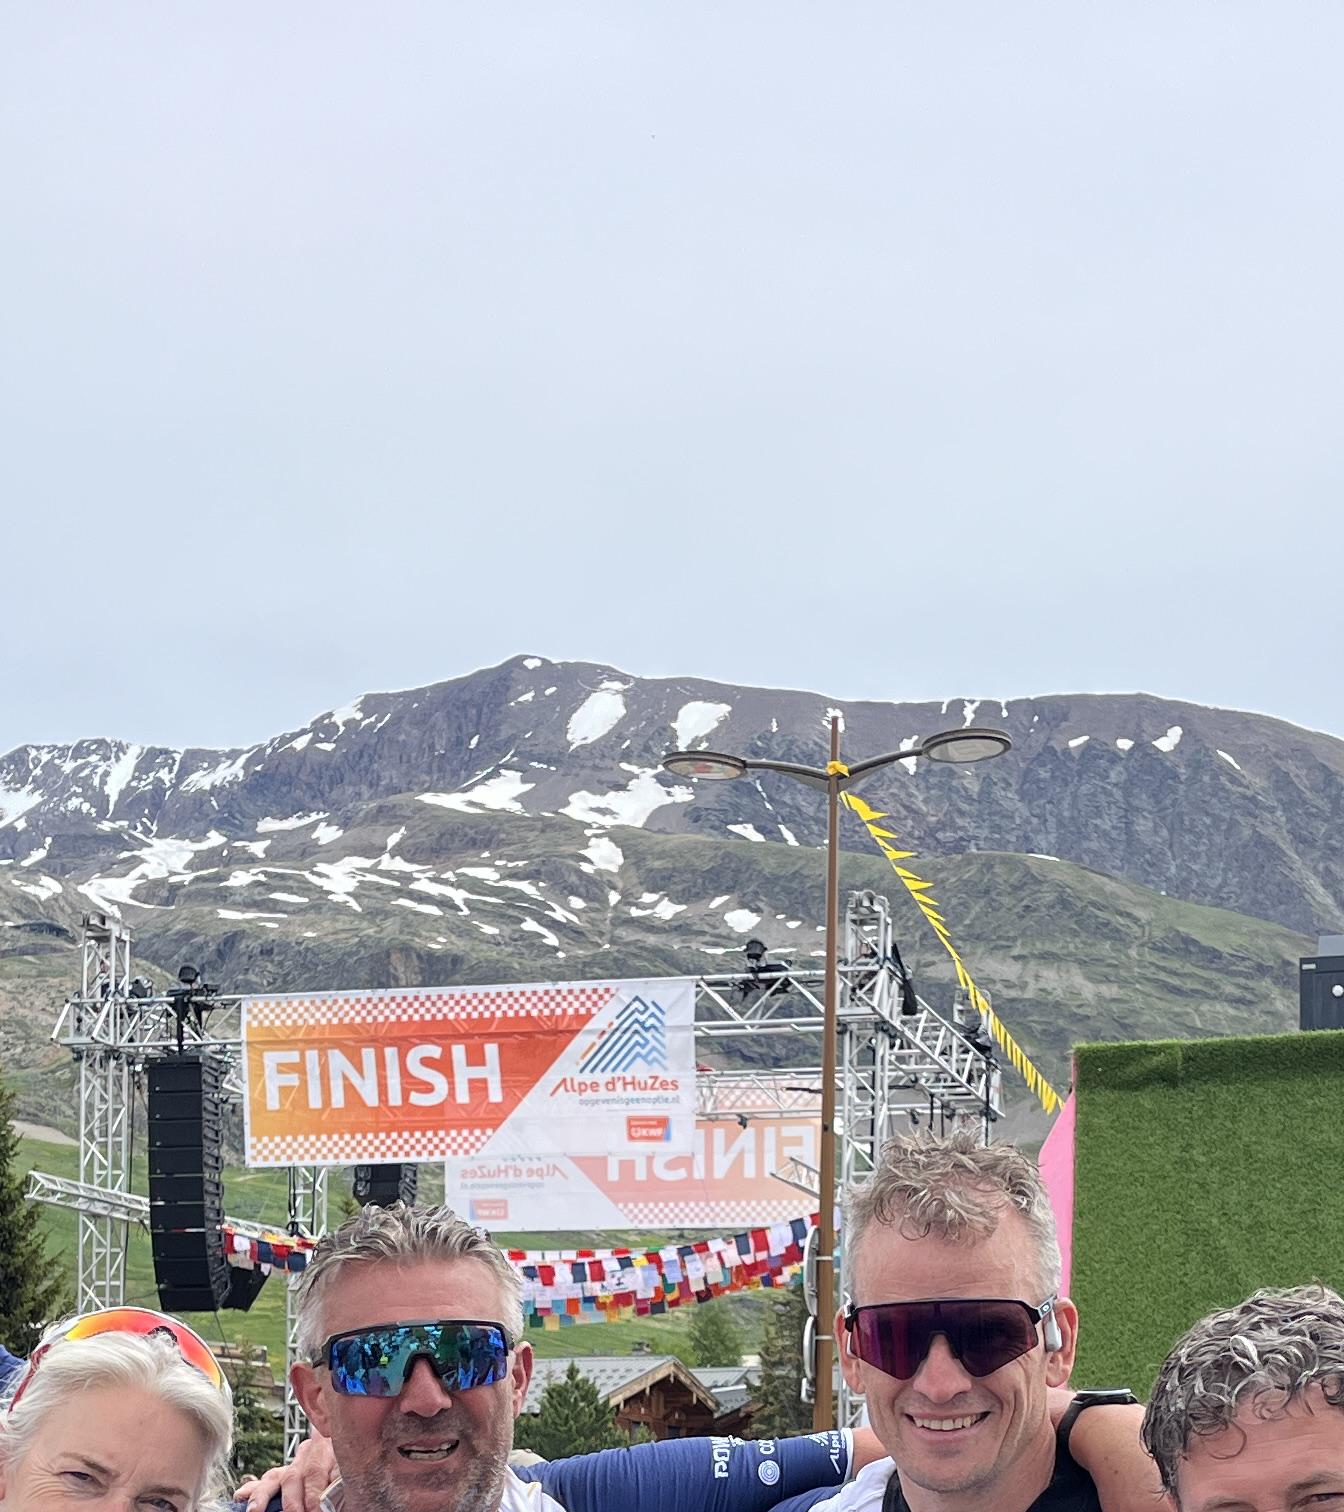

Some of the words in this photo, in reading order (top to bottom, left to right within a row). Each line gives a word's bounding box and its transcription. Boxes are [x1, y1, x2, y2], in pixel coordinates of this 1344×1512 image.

[263, 1043, 503, 1112] FINISH
[550, 1077, 599, 1097] Alpe
[606, 1076, 679, 1092] d'HuZes
